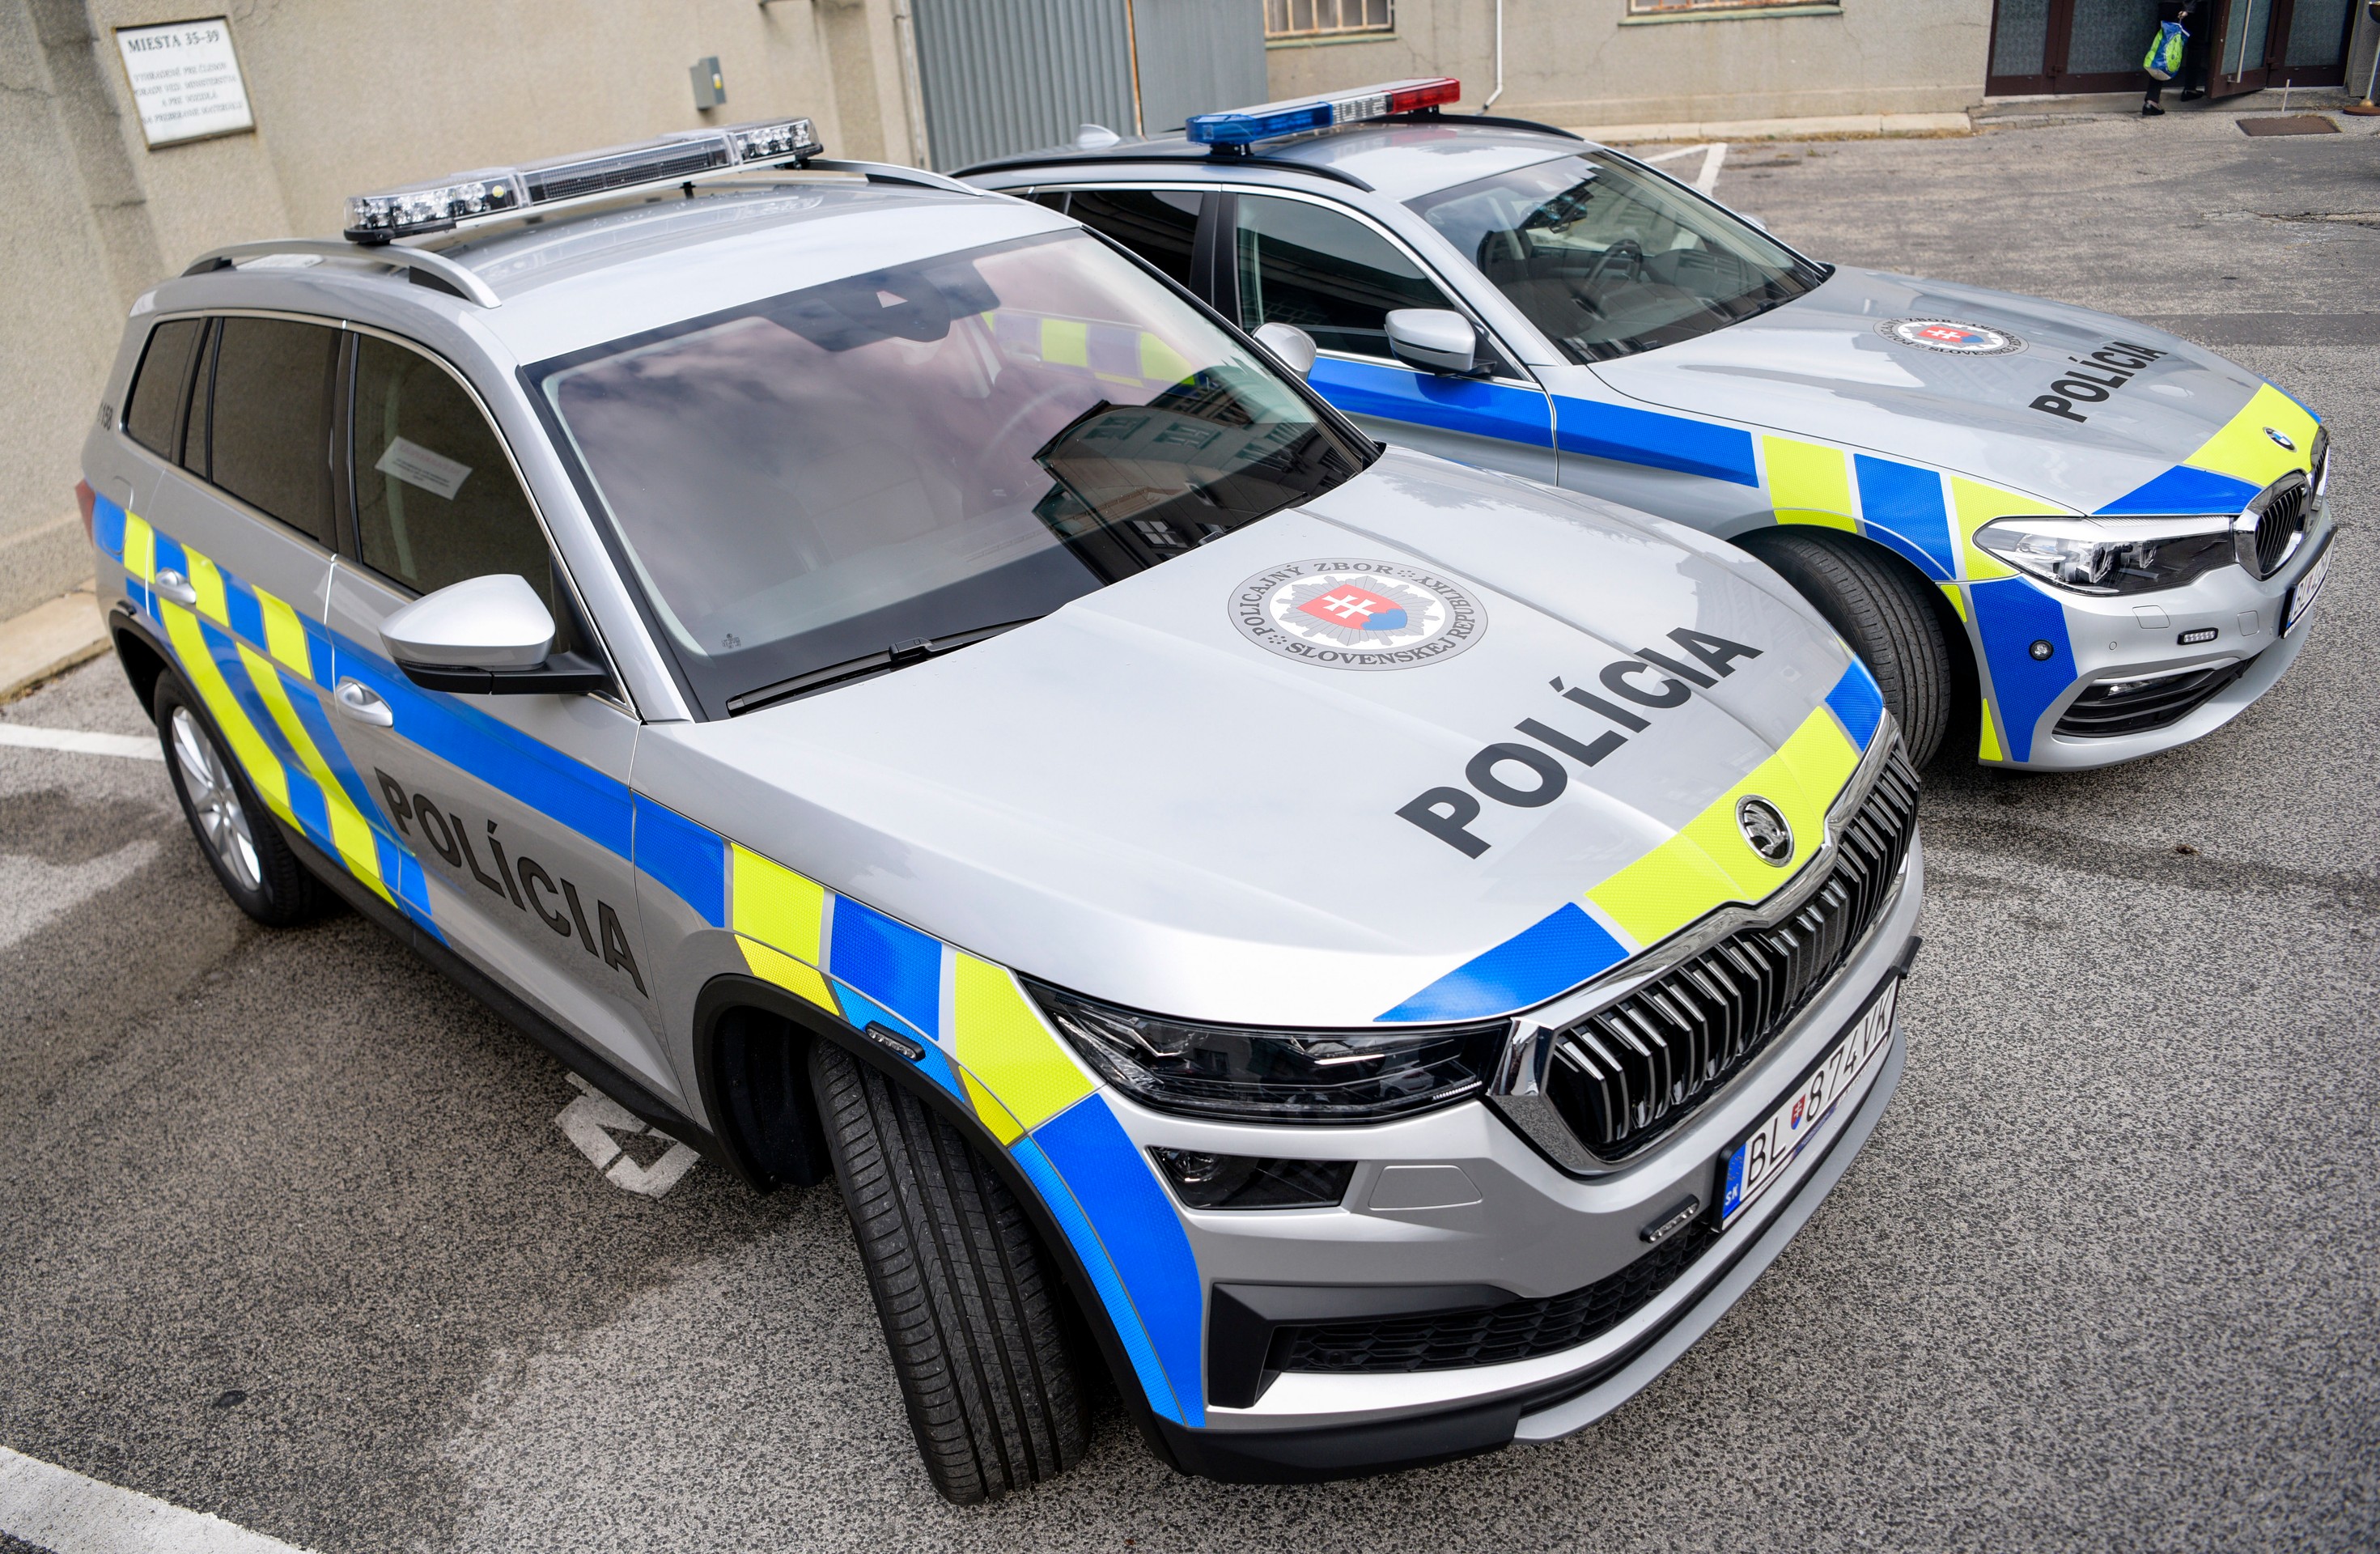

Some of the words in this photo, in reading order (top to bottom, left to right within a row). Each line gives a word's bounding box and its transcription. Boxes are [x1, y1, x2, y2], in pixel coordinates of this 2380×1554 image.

[127, 35, 181, 53] MIESTA
[1881, 318, 1915, 345] POLICAJNÝ
[1928, 345, 2018, 356] SLOVENSKEJ
[2028, 341, 2169, 423] POLÍCIA
[1240, 564, 1302, 637] POLICAJNÝ
[1313, 562, 1394, 575] ZBOR
[1285, 636, 1457, 665] SLOVENSKEJ
[1413, 575, 1475, 639] REPUBLIKY
[1394, 626, 1764, 860] POLÍCIA
[374, 766, 649, 1000] POLÍCIA
[1746, 1116, 1786, 1189] BL
[1806, 985, 1893, 1123] 874VK
[1725, 1183, 1739, 1206] SK
